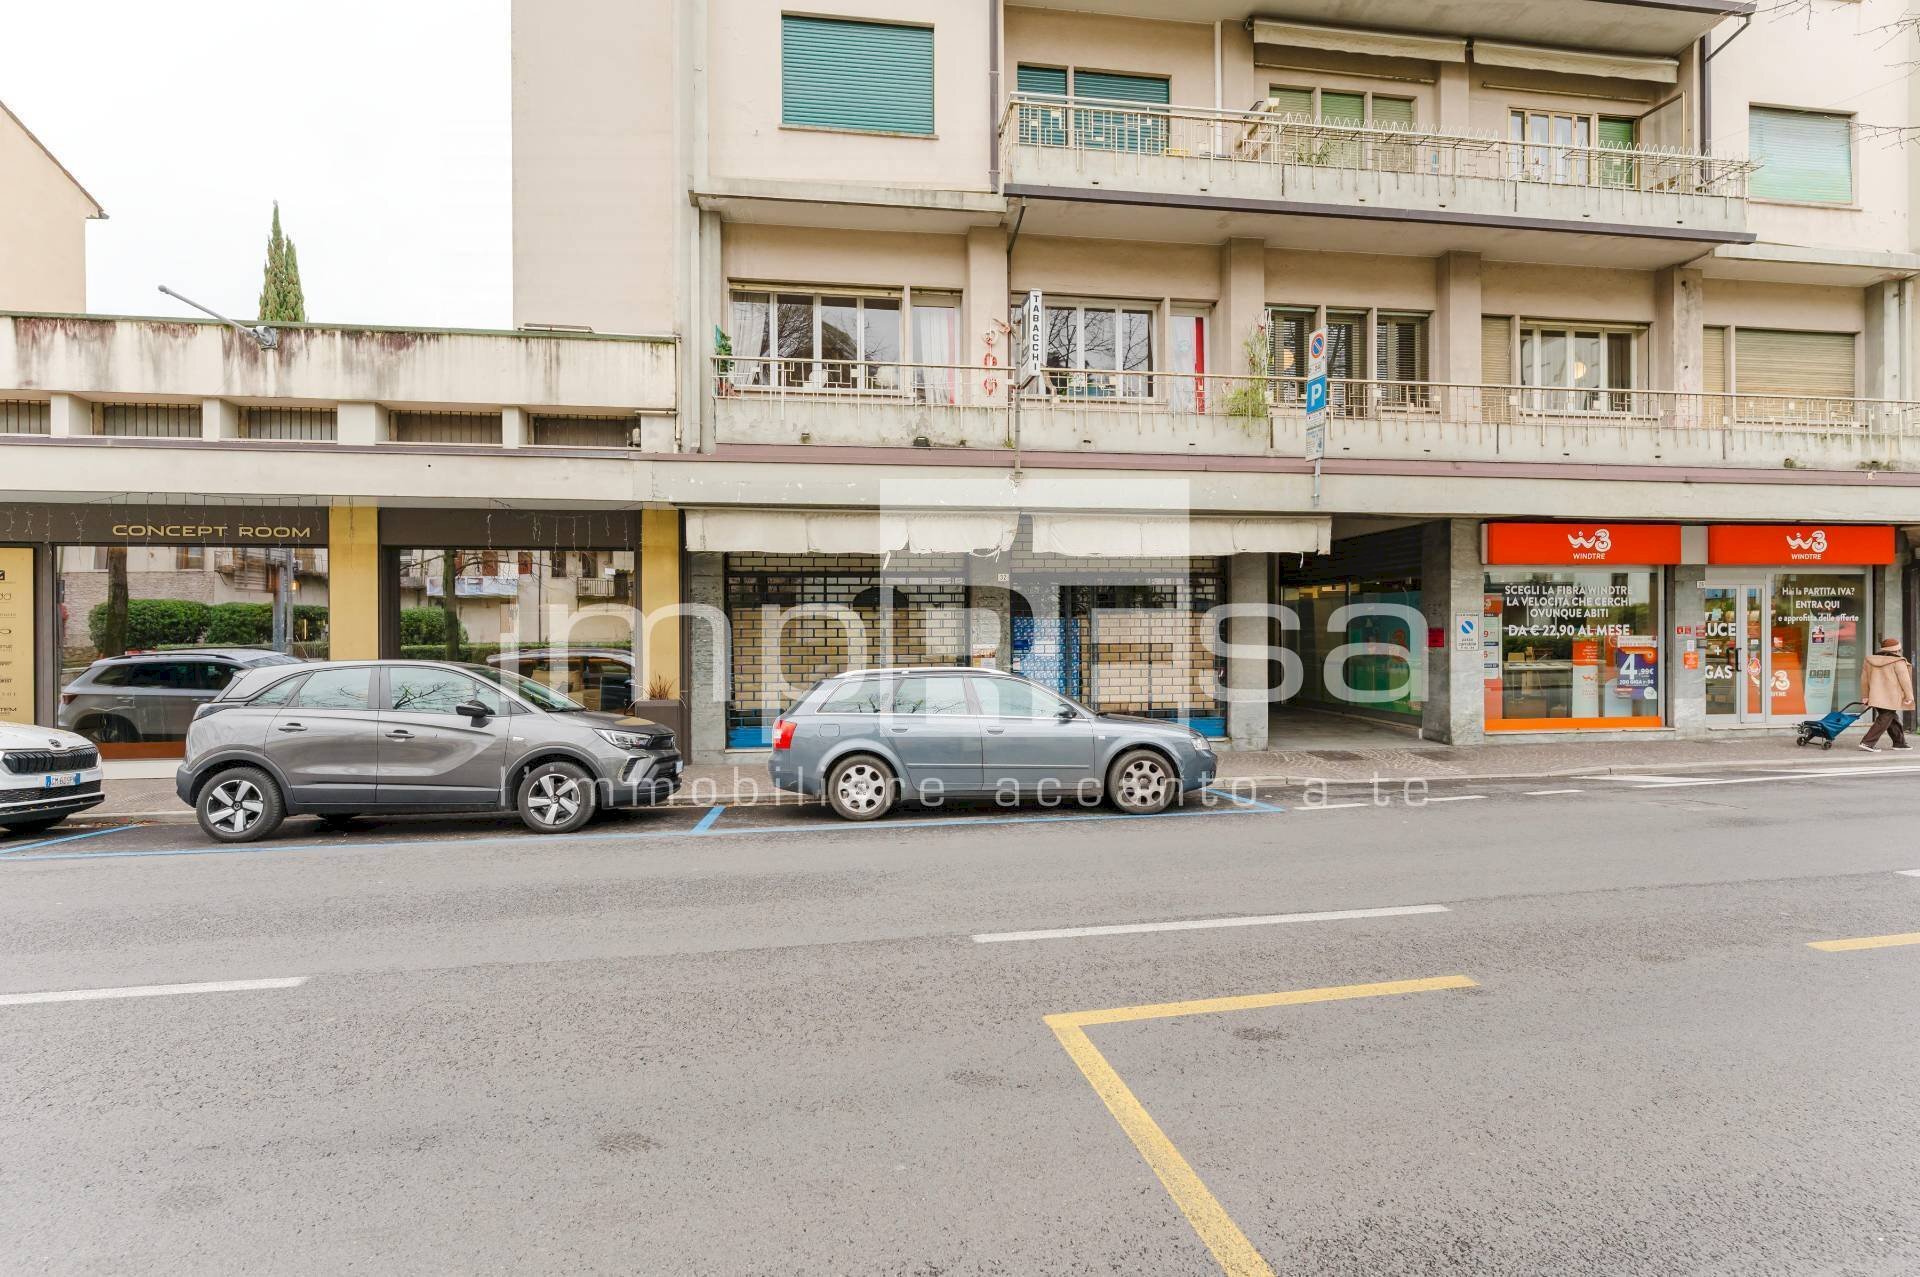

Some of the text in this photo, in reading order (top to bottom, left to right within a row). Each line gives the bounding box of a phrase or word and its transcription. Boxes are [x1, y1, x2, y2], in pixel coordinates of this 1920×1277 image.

[1032, 294, 1040, 371] TABACCHI
[1311, 383, 1322, 407] P
[112, 524, 311, 538] CONCEPT ROOM
[1572, 552, 1606, 560] WINDTRE
[1504, 585, 1633, 595] SCEGLI LA FIBRA WINDTRE
[1803, 587, 1837, 596] PARTITA
[1838, 587, 1855, 596] IVA?
[1506, 597, 1519, 606] LA
[1571, 597, 1593, 606] CHE
[1594, 597, 1633, 606] CERCHI
[1795, 600, 1840, 611] ENTRA QUI
[1530, 608, 1609, 619] OVUNQUE ABITI
[1835, 613, 1859, 622] offerte
[1508, 624, 1630, 639] DA € 22,90 AL MESE
[1705, 623, 1736, 636] UCE
[1704, 665, 1733, 679] GAS
